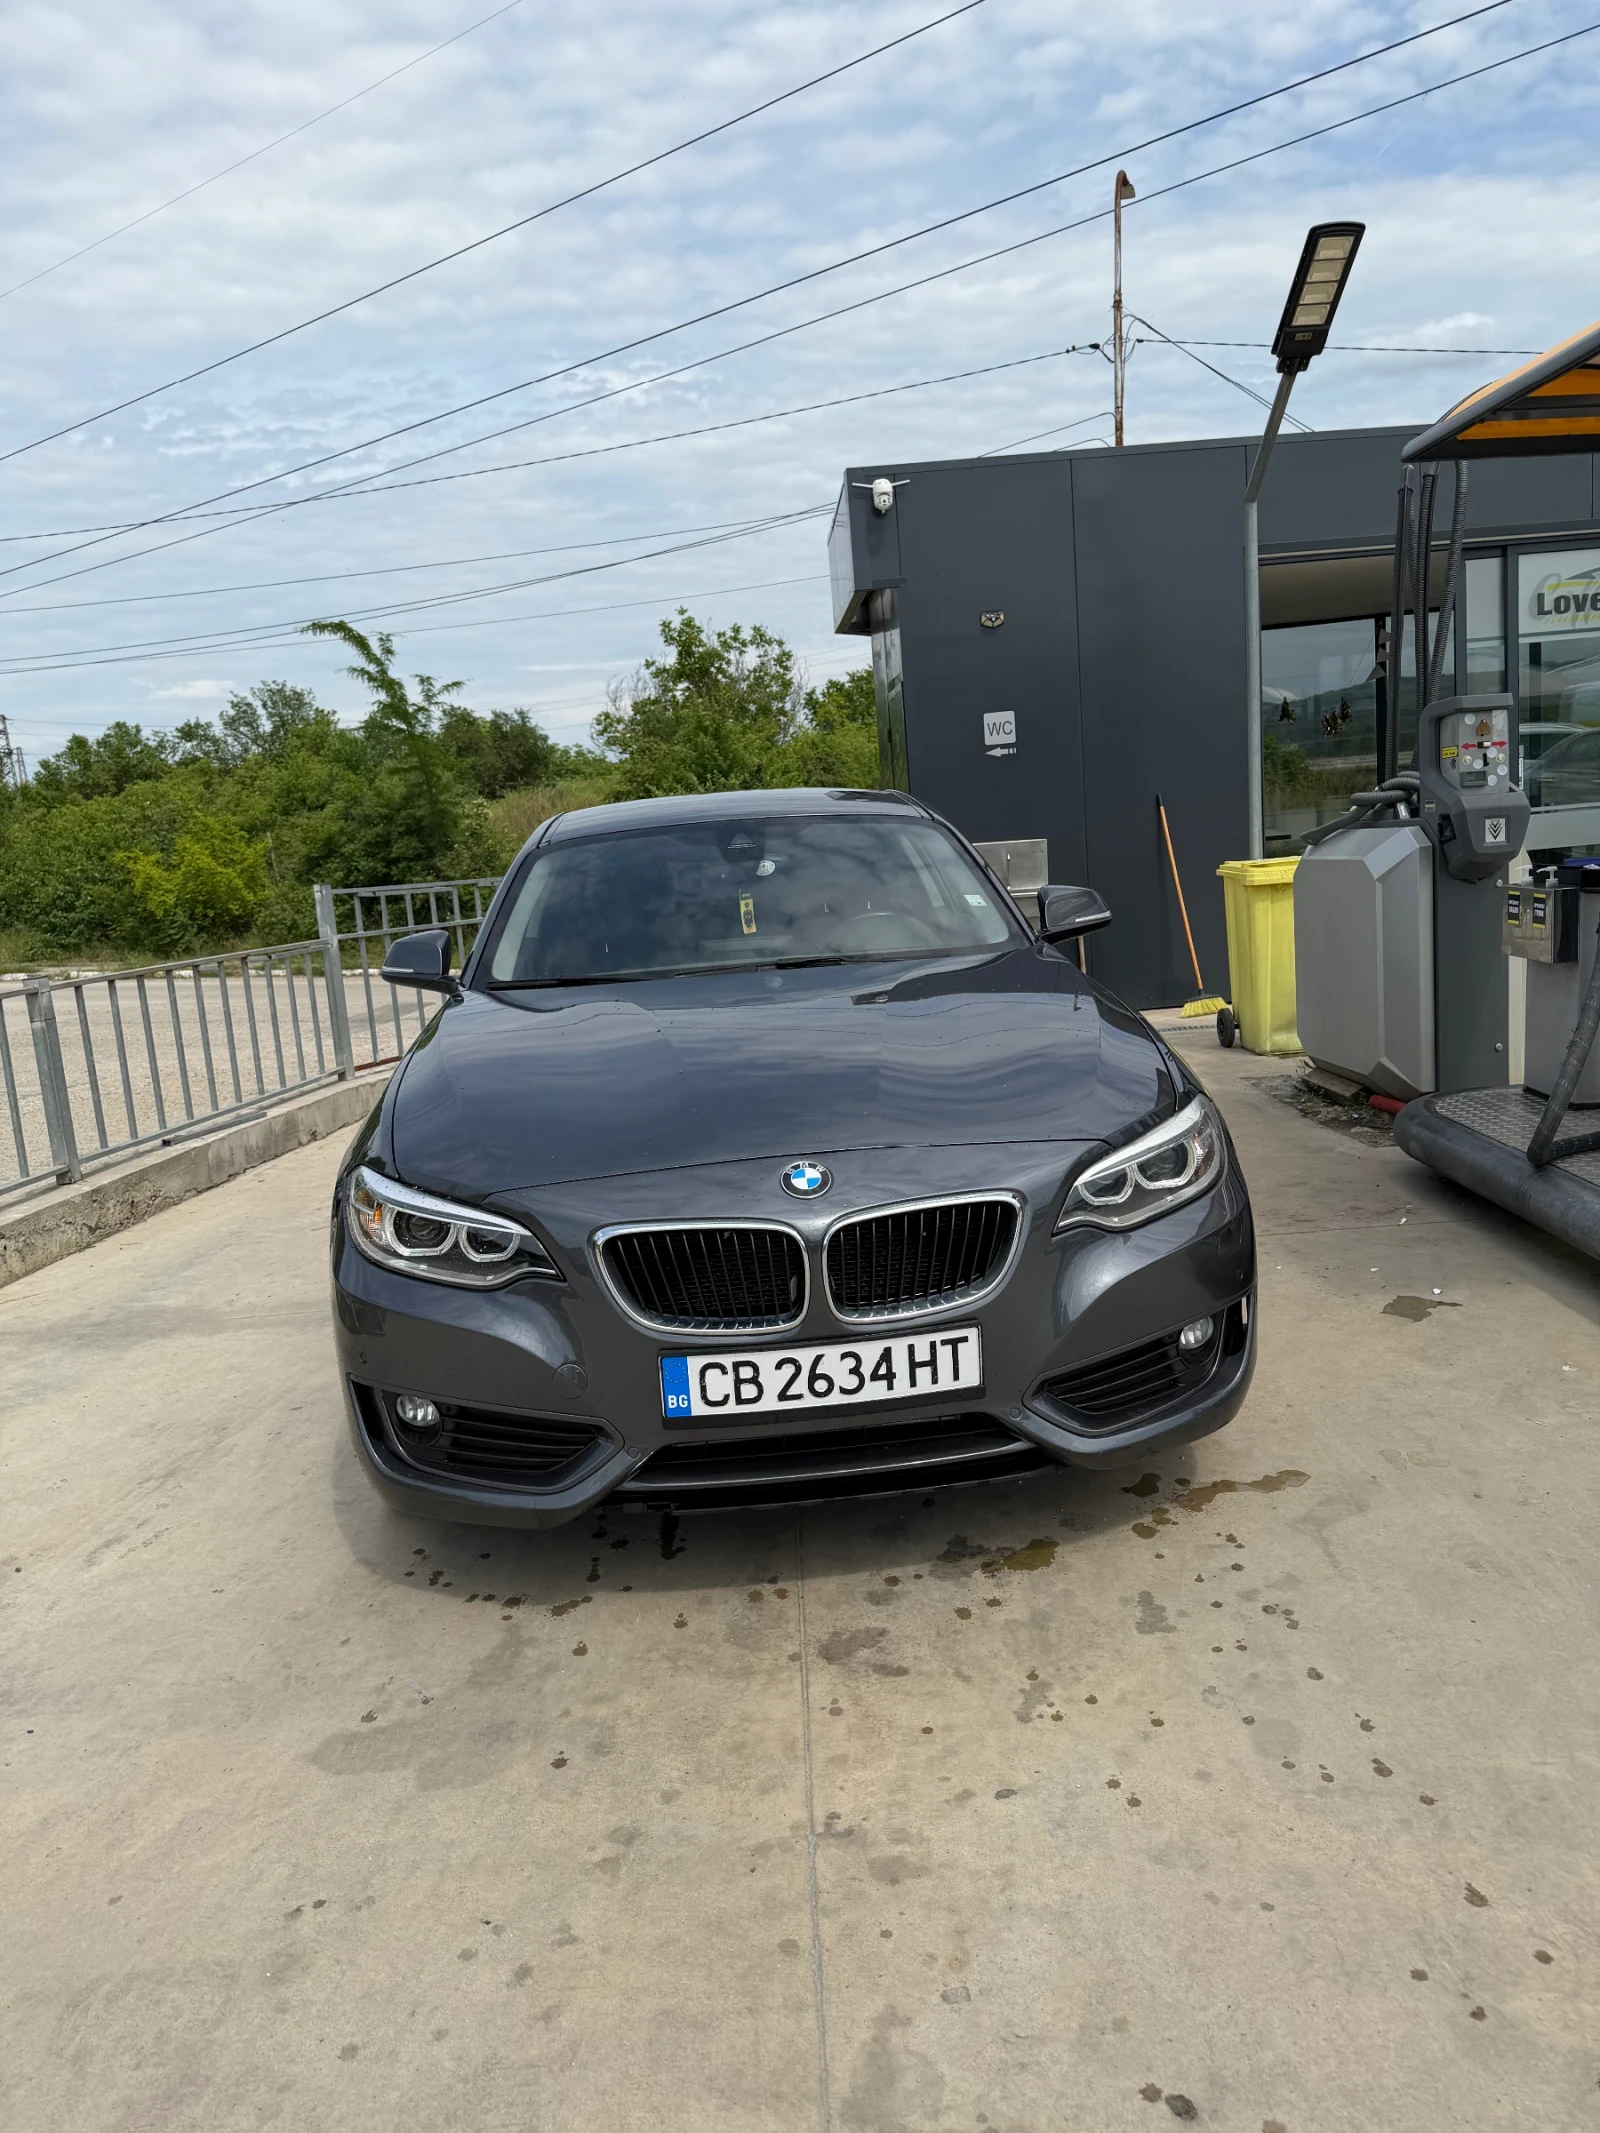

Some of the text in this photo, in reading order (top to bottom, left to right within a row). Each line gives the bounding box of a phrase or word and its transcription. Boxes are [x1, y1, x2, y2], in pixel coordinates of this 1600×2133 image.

[987, 720, 1013, 737] WC
[787, 1162, 825, 1174] BMW
[698, 1335, 969, 1407] CB 2634 HT
[667, 1394, 689, 1409] BG
